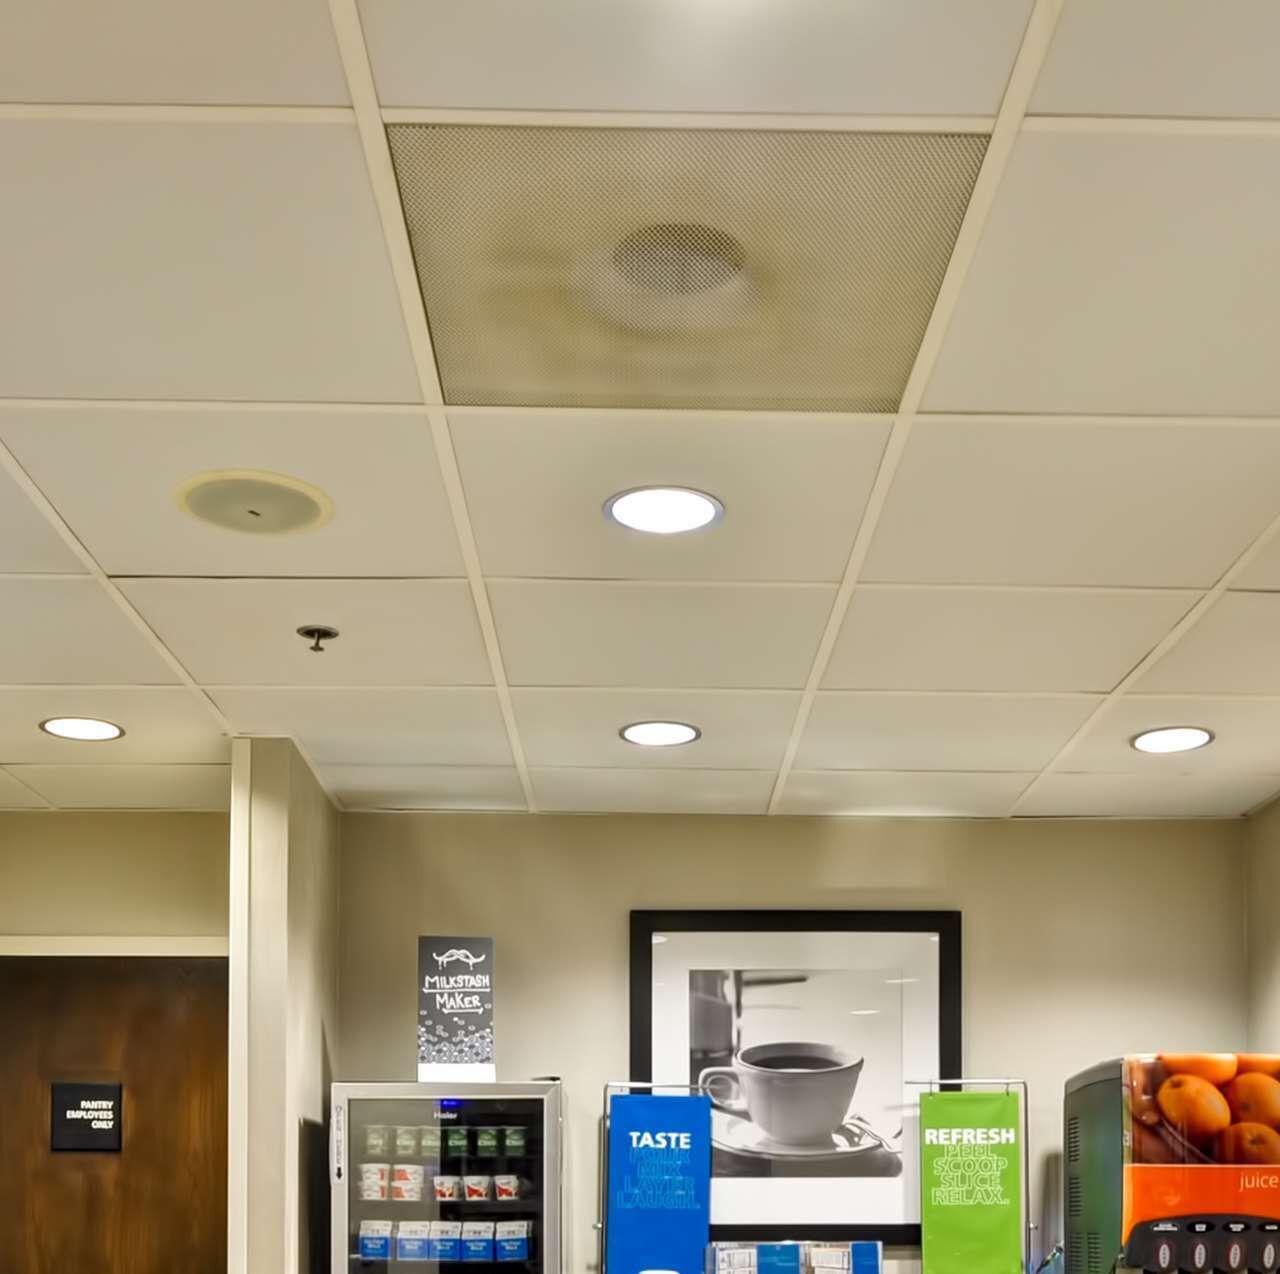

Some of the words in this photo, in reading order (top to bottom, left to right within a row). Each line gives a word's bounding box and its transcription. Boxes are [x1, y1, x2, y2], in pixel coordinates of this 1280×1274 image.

[425, 974, 489, 989] MILKSTASH
[80, 1100, 114, 1109] PANTRY
[66, 1110, 114, 1119] EMPLOYEES
[91, 1120, 114, 1129] ONLY
[628, 1132, 691, 1149] TASTE
[925, 1128, 1015, 1144] REFRESH
[944, 1143, 996, 1158] PEEL
[933, 1157, 1008, 1174] SCOOP
[940, 1172, 1002, 1188] SLICE
[1239, 1172, 1279, 1192] juice
[931, 1187, 1010, 1205] RELAX.
